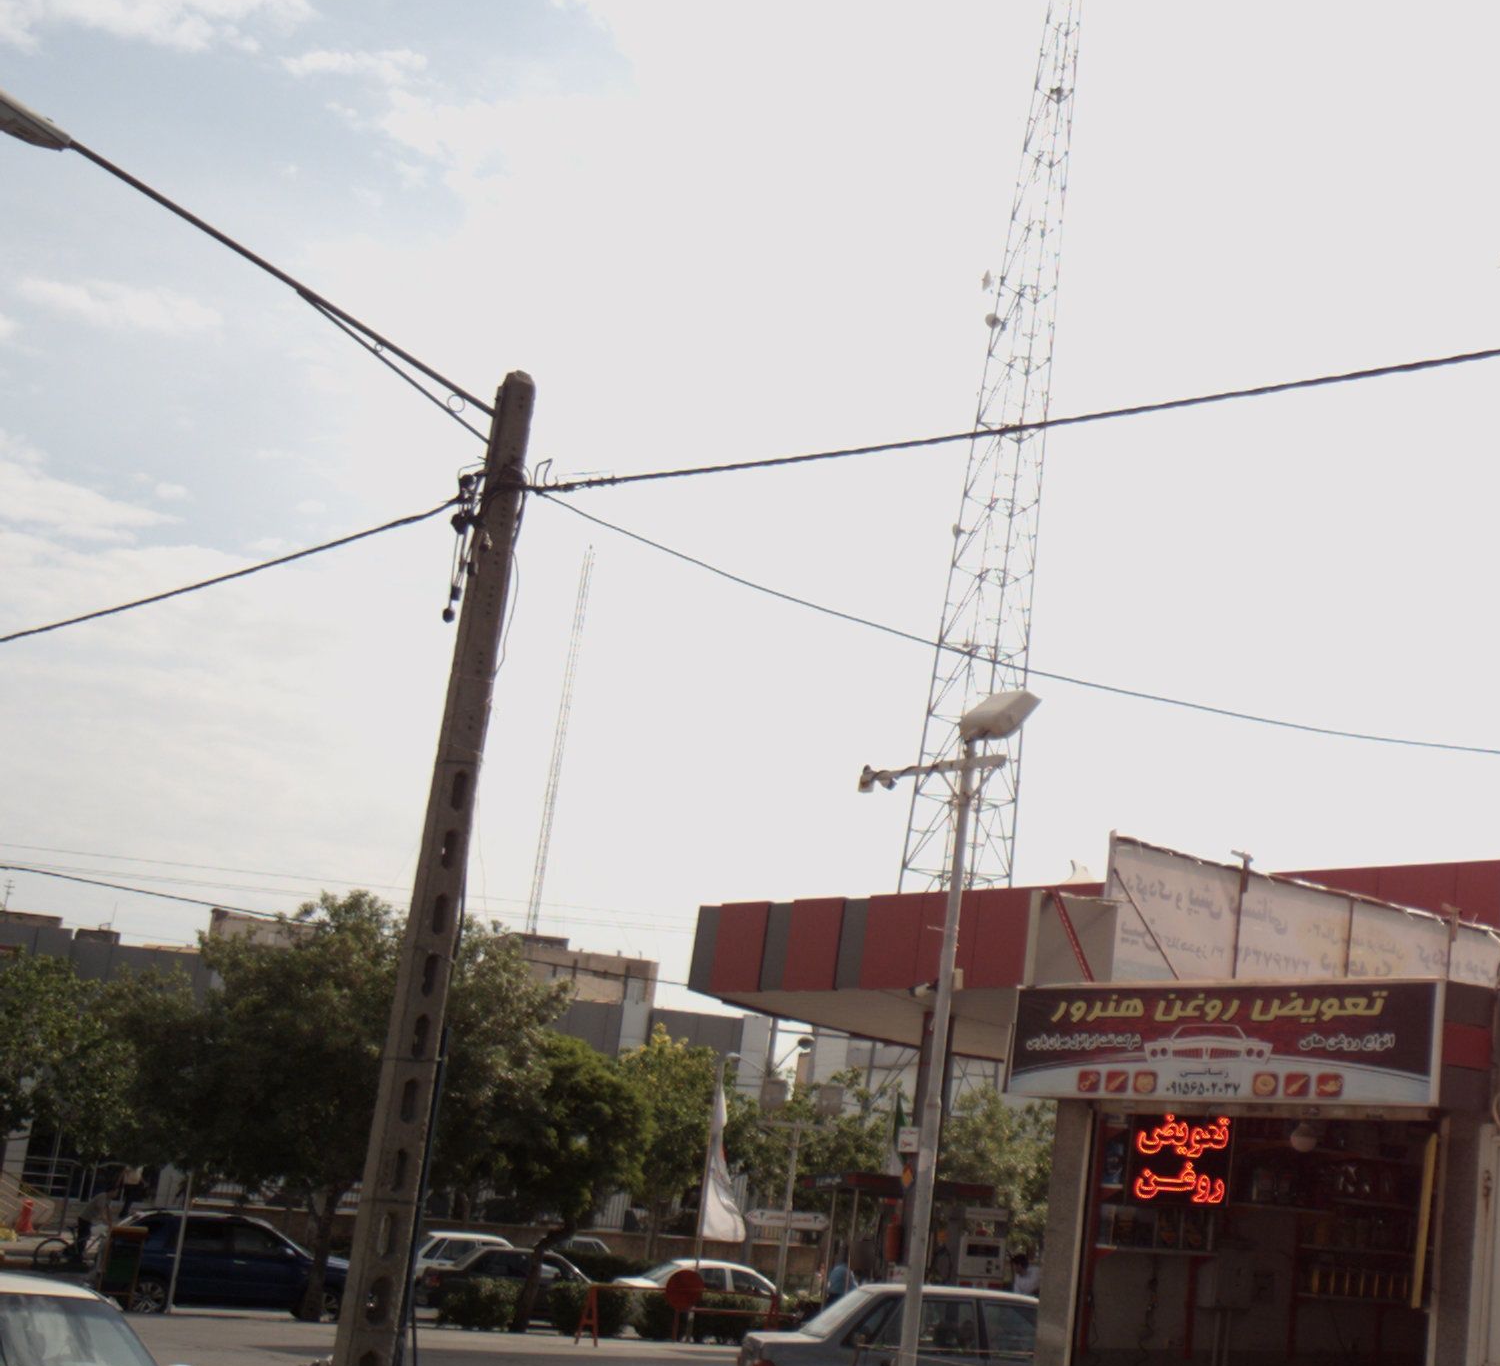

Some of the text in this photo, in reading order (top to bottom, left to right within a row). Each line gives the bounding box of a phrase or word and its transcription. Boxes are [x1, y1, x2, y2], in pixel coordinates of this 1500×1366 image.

[1050, 990, 1388, 1023] تعویض روغن هنرور
[1298, 1032, 1396, 1052] انواع روغن های
[1136, 1112, 1231, 1159] تعویض
[1133, 1160, 1226, 1205] روغن
